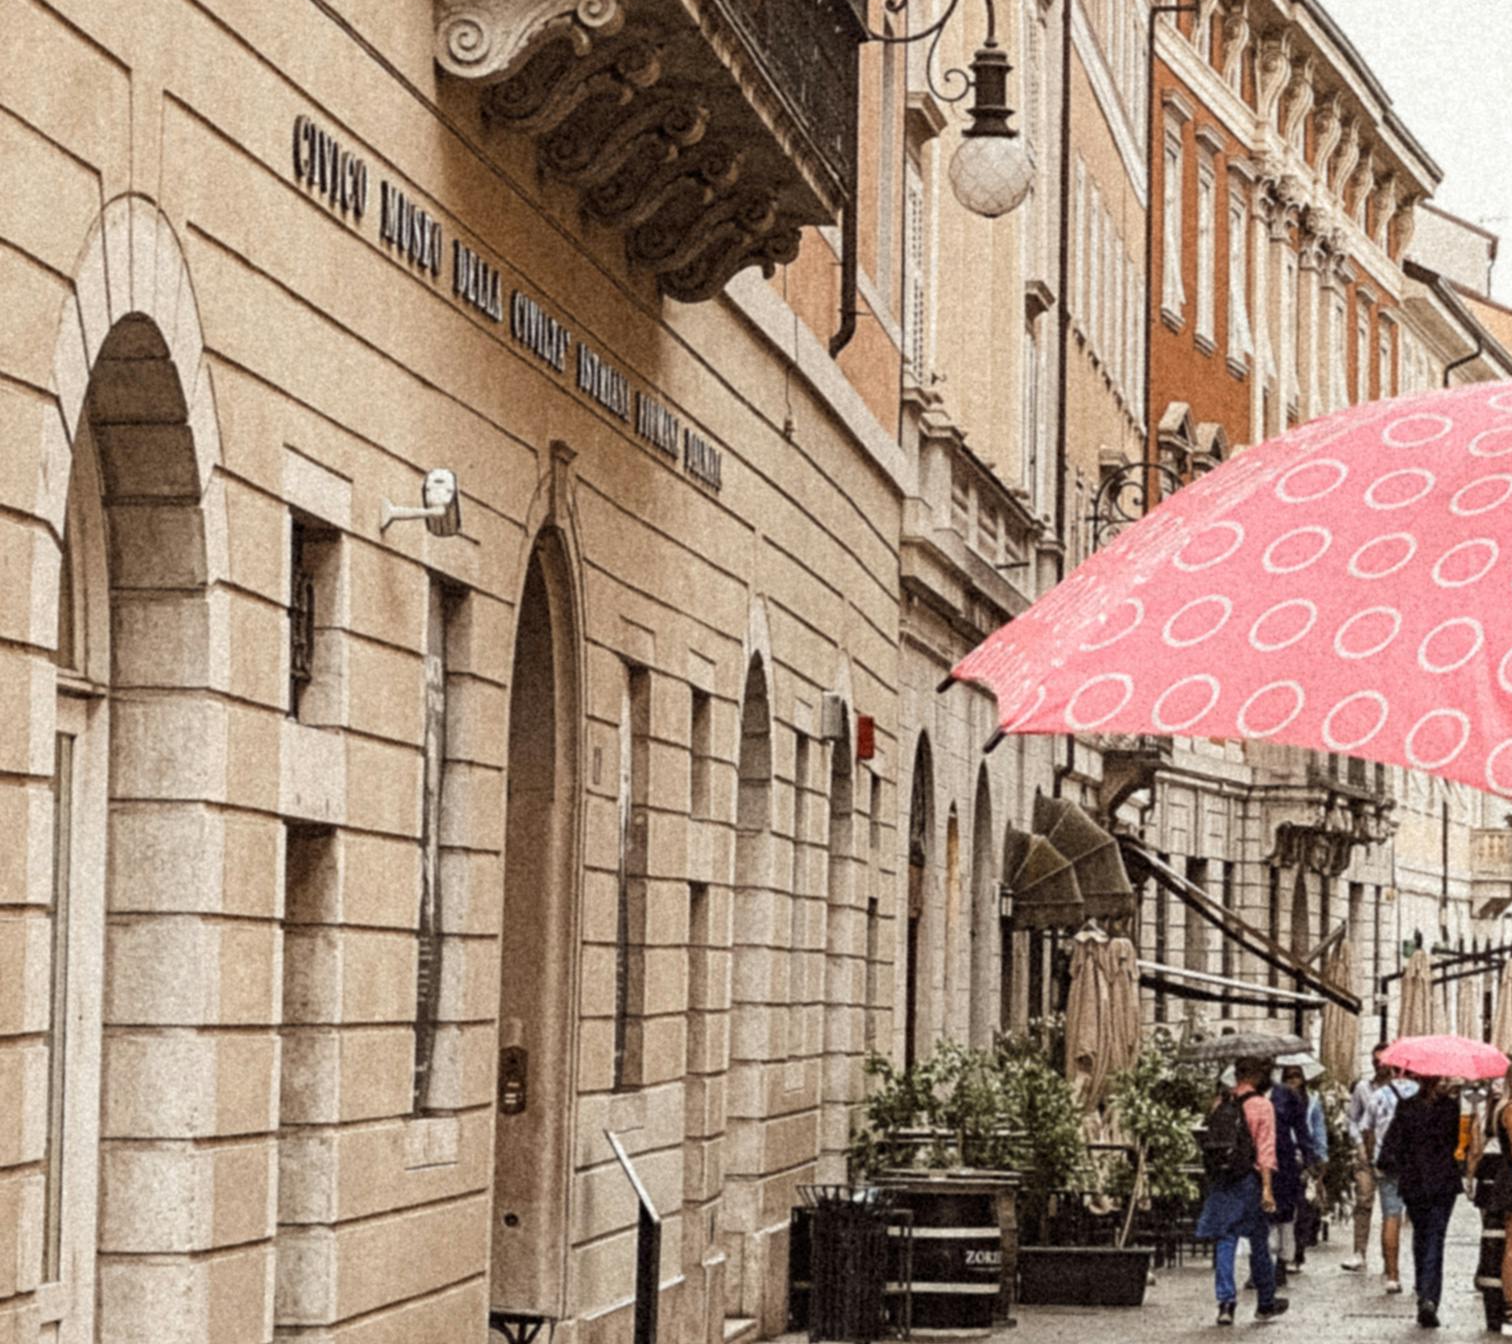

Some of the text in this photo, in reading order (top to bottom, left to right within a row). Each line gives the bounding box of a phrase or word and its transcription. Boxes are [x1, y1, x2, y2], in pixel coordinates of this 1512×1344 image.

[293, 115, 367, 218] CIVICO
[380, 180, 442, 279] MUSEO
[453, 239, 502, 324] DELLA
